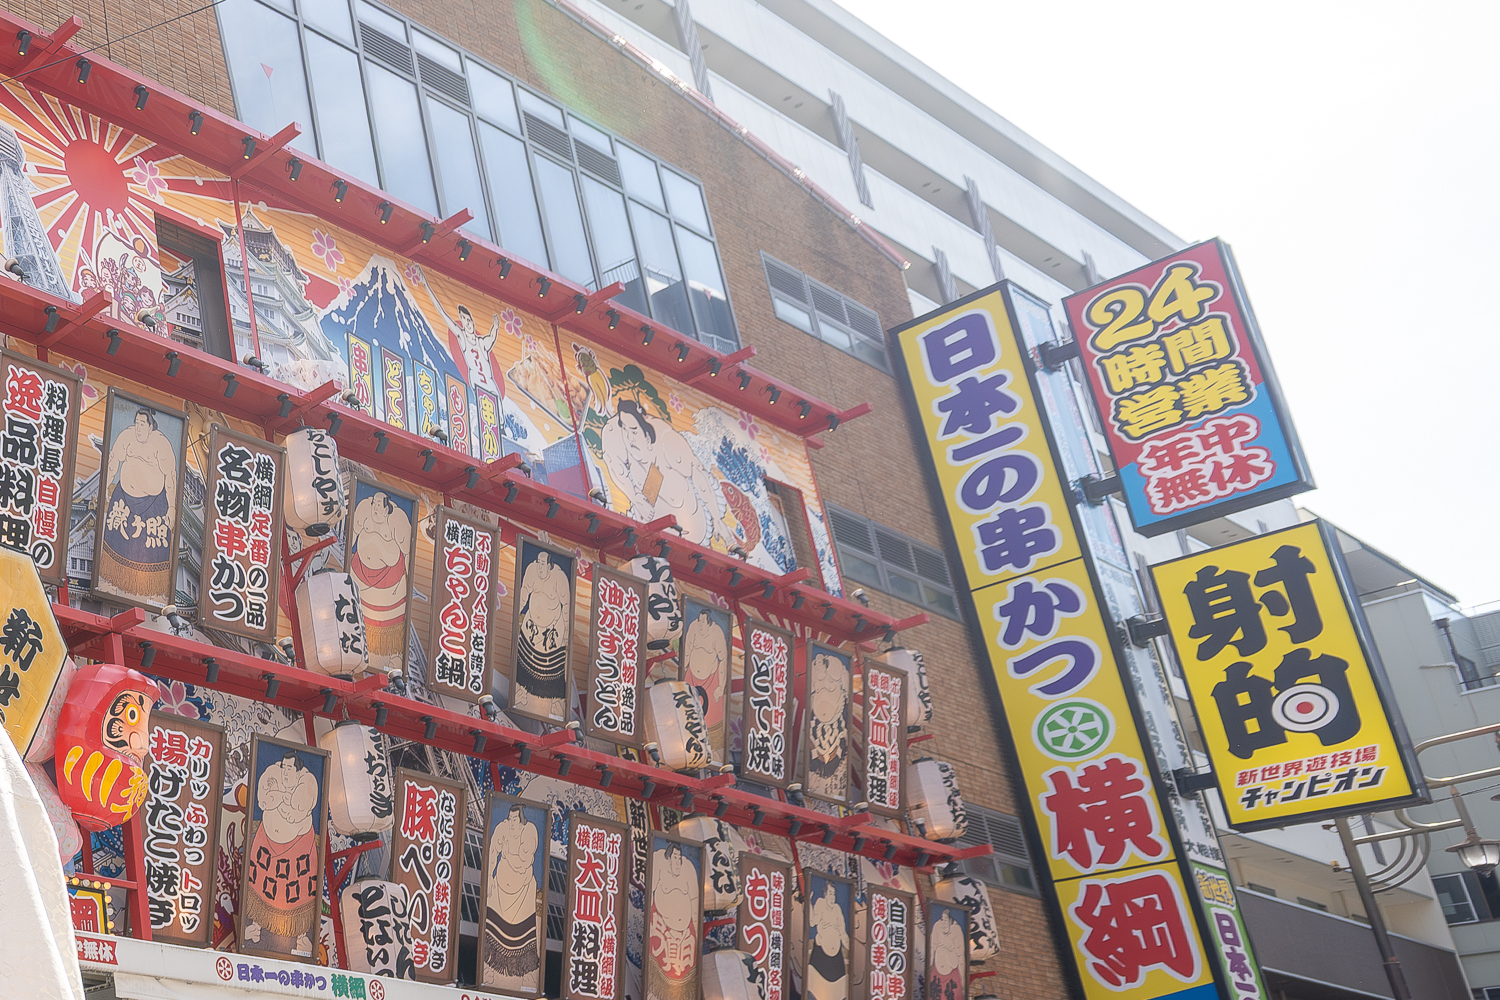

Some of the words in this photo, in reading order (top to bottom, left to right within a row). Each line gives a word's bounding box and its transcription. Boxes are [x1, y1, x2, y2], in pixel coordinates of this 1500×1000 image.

[1094, 266, 1214, 342] 24
[351, 343, 371, 417] 串か
[1103, 316, 1234, 389] 時間
[1116, 365, 1248, 437] 営業
[1141, 417, 1255, 472] 年中
[34, 381, 68, 567] 料理長自慢の
[1150, 456, 1270, 513] 無休
[210, 444, 253, 620] 名物串かつ
[246, 454, 276, 629] 横綱定番の一品
[444, 519, 474, 550] 横綱
[437, 546, 472, 688] ちゃんこ鍋
[470, 532, 491, 693] 不動の人気を誇る
[595, 578, 624, 730] 油かすうどん
[751, 631, 775, 656] 名物
[922, 312, 1096, 697] 日本一の串かつ
[1045, 757, 1196, 986] 横綱
[1184, 545, 1362, 759] 射的
[619, 587, 640, 735] 大阪名物逸品
[747, 655, 774, 774] どて焼
[771, 638, 787, 780] 大阪下町の味
[868, 692, 890, 805] 大皿料理
[189, 738, 211, 799] カリッ
[1237, 745, 1378, 788] 新世界遊技場
[1242, 767, 1386, 808] チャンピオン
[146, 728, 190, 928] 揚げたこ焼き
[184, 804, 208, 866] ふわっ
[576, 825, 606, 855] 横綱
[180, 870, 203, 933] トロッ
[430, 793, 456, 972] なにわの鉄板焼き
[571, 850, 604, 997] 大皿料理
[600, 832, 622, 1000] ボリューム横綱級
[770, 872, 785, 928] 味自慢
[237, 963, 327, 991] 日本一の串かつ
[331, 972, 367, 1000] 横綱
